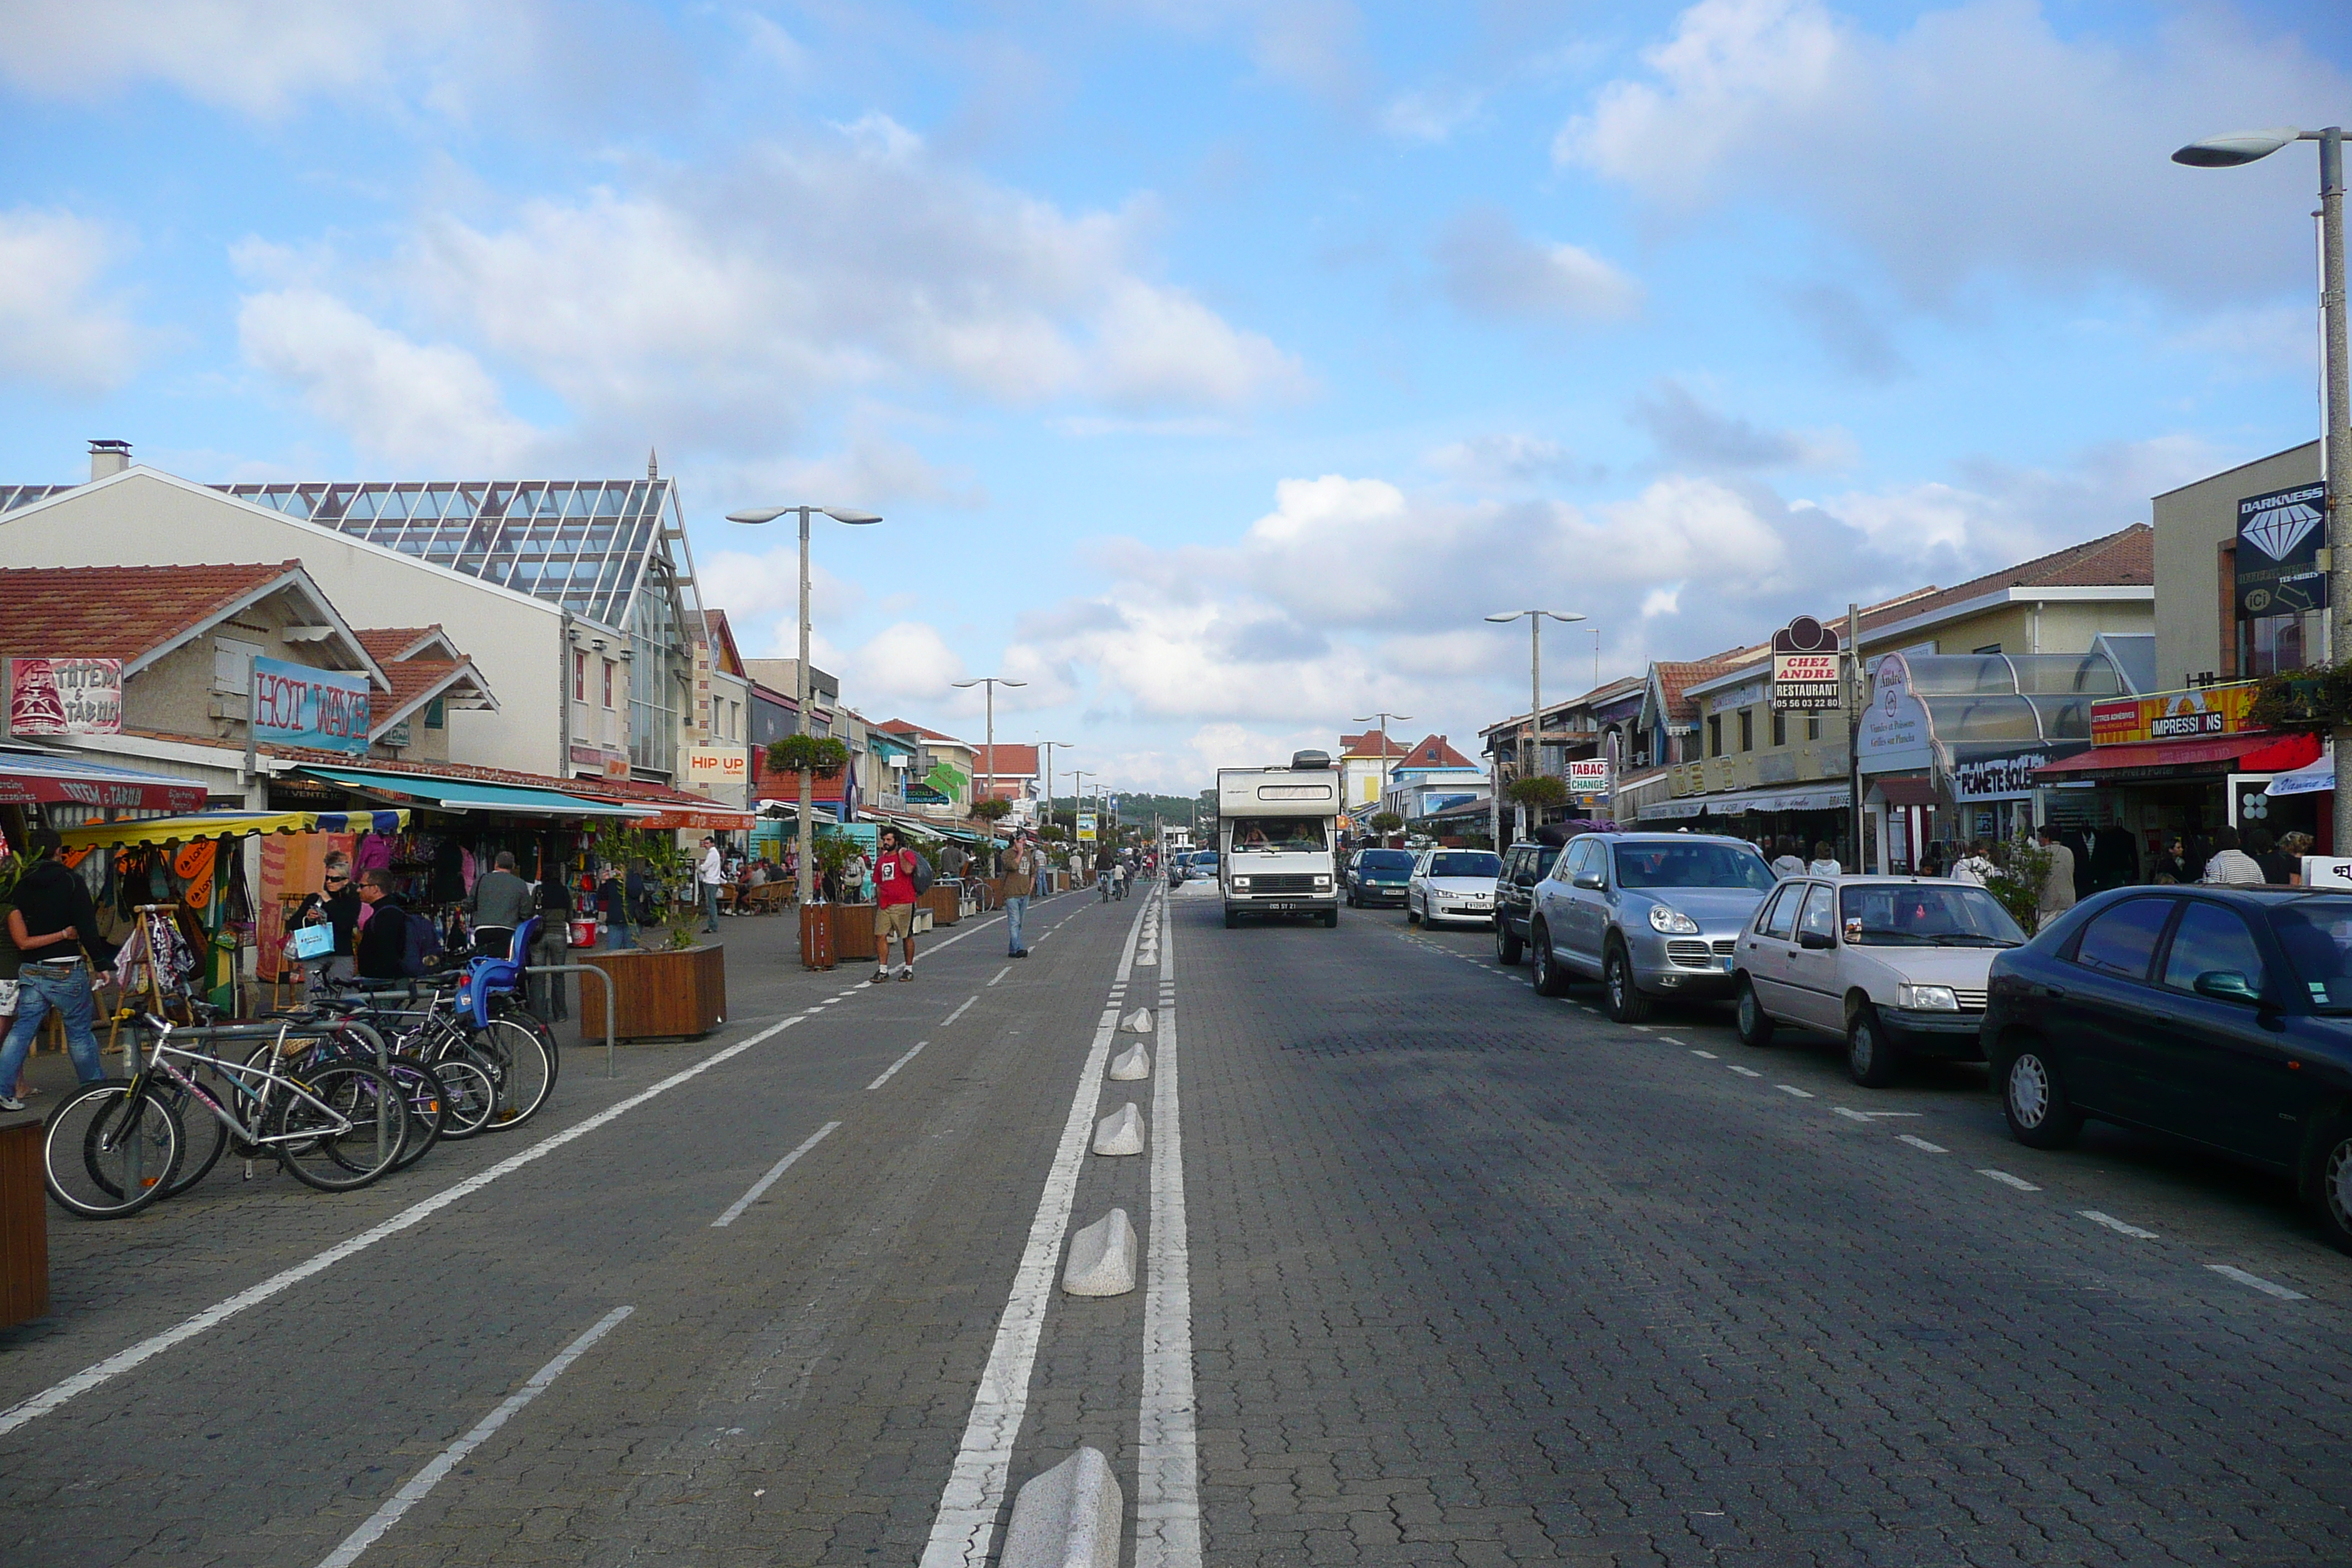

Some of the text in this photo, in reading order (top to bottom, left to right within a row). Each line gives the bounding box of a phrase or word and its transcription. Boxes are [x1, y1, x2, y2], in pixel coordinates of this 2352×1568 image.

[2241, 487, 2323, 514] DARKNESS
[2279, 572, 2319, 584] TEE-SHIRTS
[1787, 657, 1830, 667] CHEZ
[55, 663, 121, 688] TOTEM
[1778, 668, 1835, 679] ANDRE
[75, 688, 83, 701] &
[1776, 684, 1838, 697] RESTAURANT
[255, 672, 369, 740] HOT WAVE
[1776, 698, 1838, 707] 05 56 03 22 80
[65, 701, 119, 723] TABOO
[2152, 713, 2222, 736] IMPRESSIONS
[692, 756, 744, 769] HIP UP
[1572, 764, 1604, 775] TABAC
[1572, 780, 1605, 789] CHANGE
[59, 782, 101, 804] TOTEM
[110, 785, 143, 806] TABOO
[292, 790, 328, 799] VENTE
